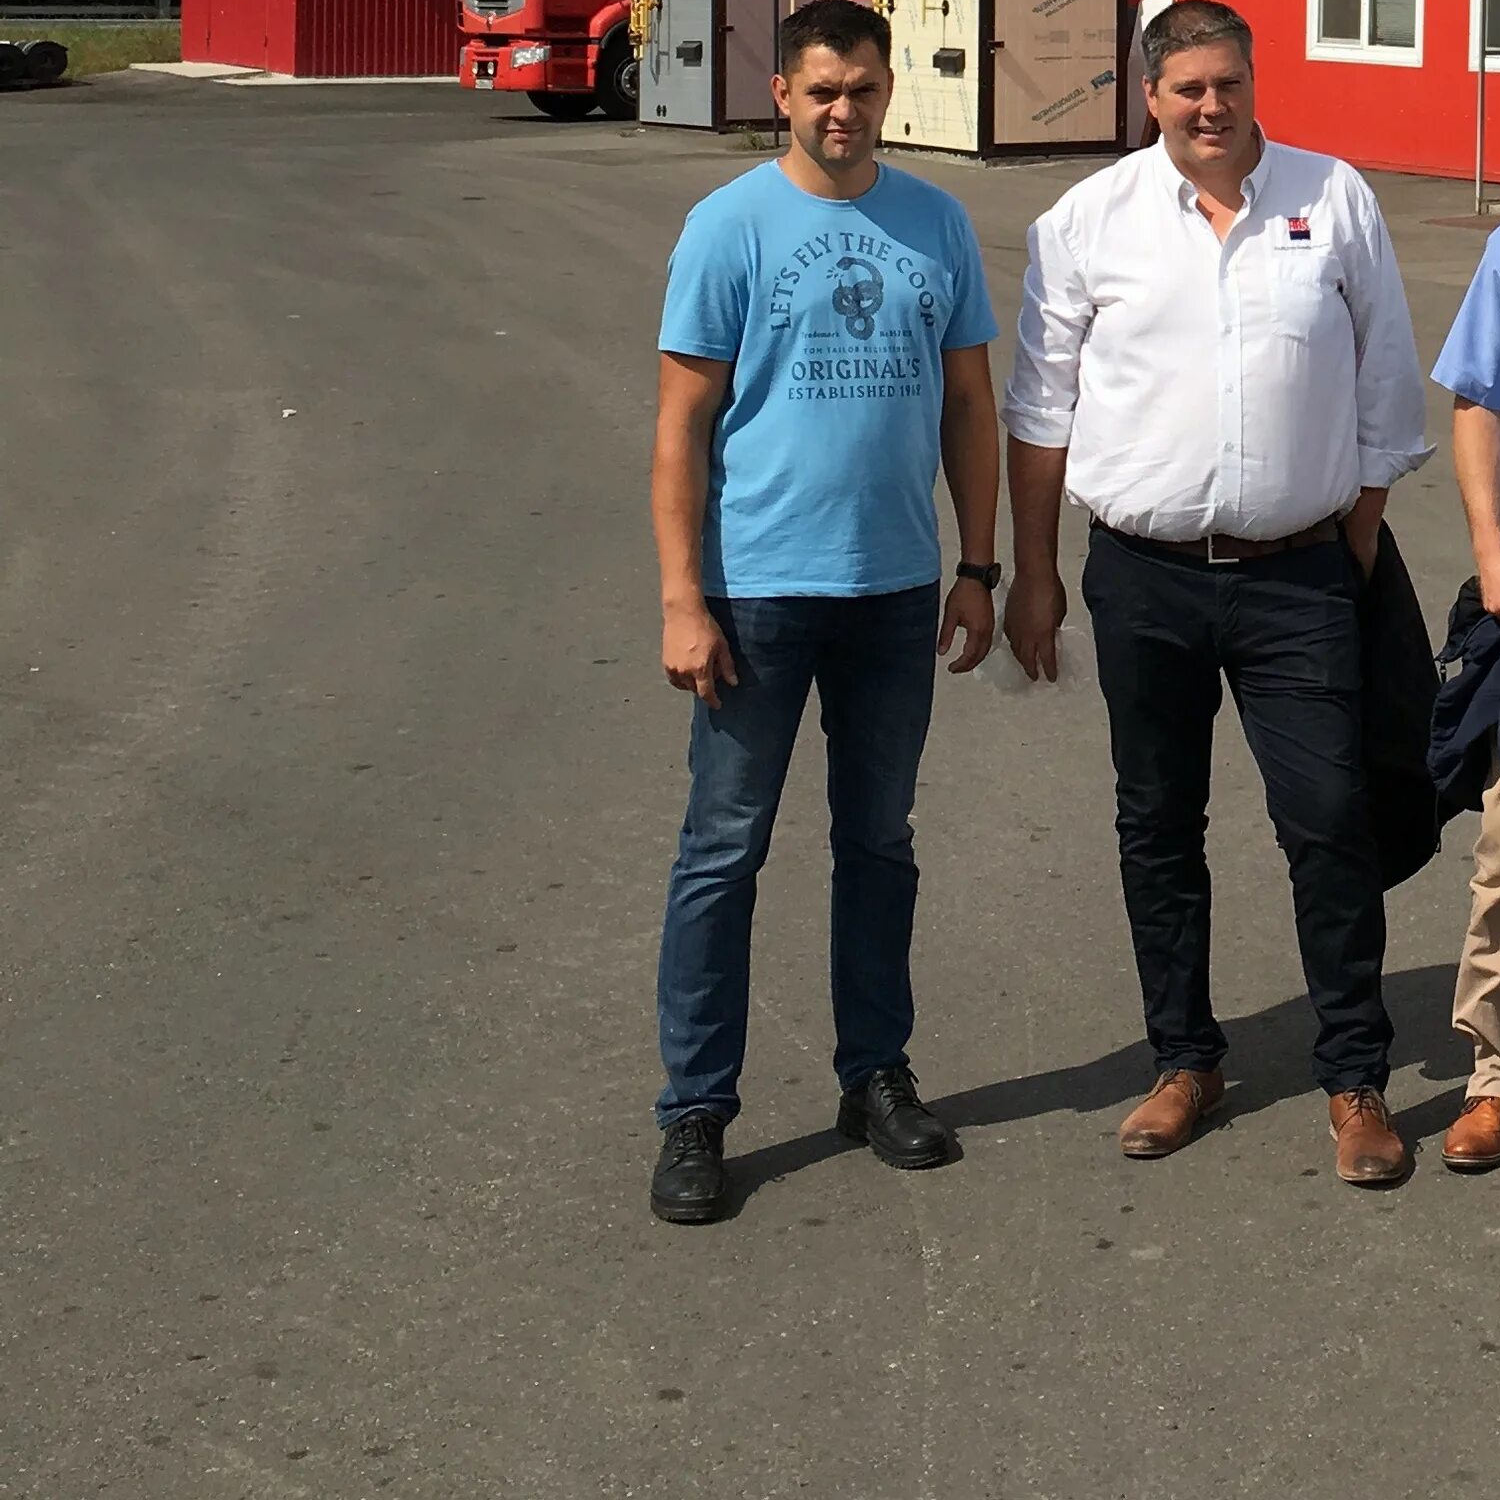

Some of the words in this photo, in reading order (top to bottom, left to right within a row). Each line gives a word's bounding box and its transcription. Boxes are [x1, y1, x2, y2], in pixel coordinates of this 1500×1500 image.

[770, 267, 801, 332] LET'S
[792, 233, 833, 269] FLY
[839, 232, 892, 262] THE
[896, 256, 935, 328] COOP
[791, 358, 921, 381] ORIGINAL'S
[788, 384, 896, 400] ESTABLISHED
